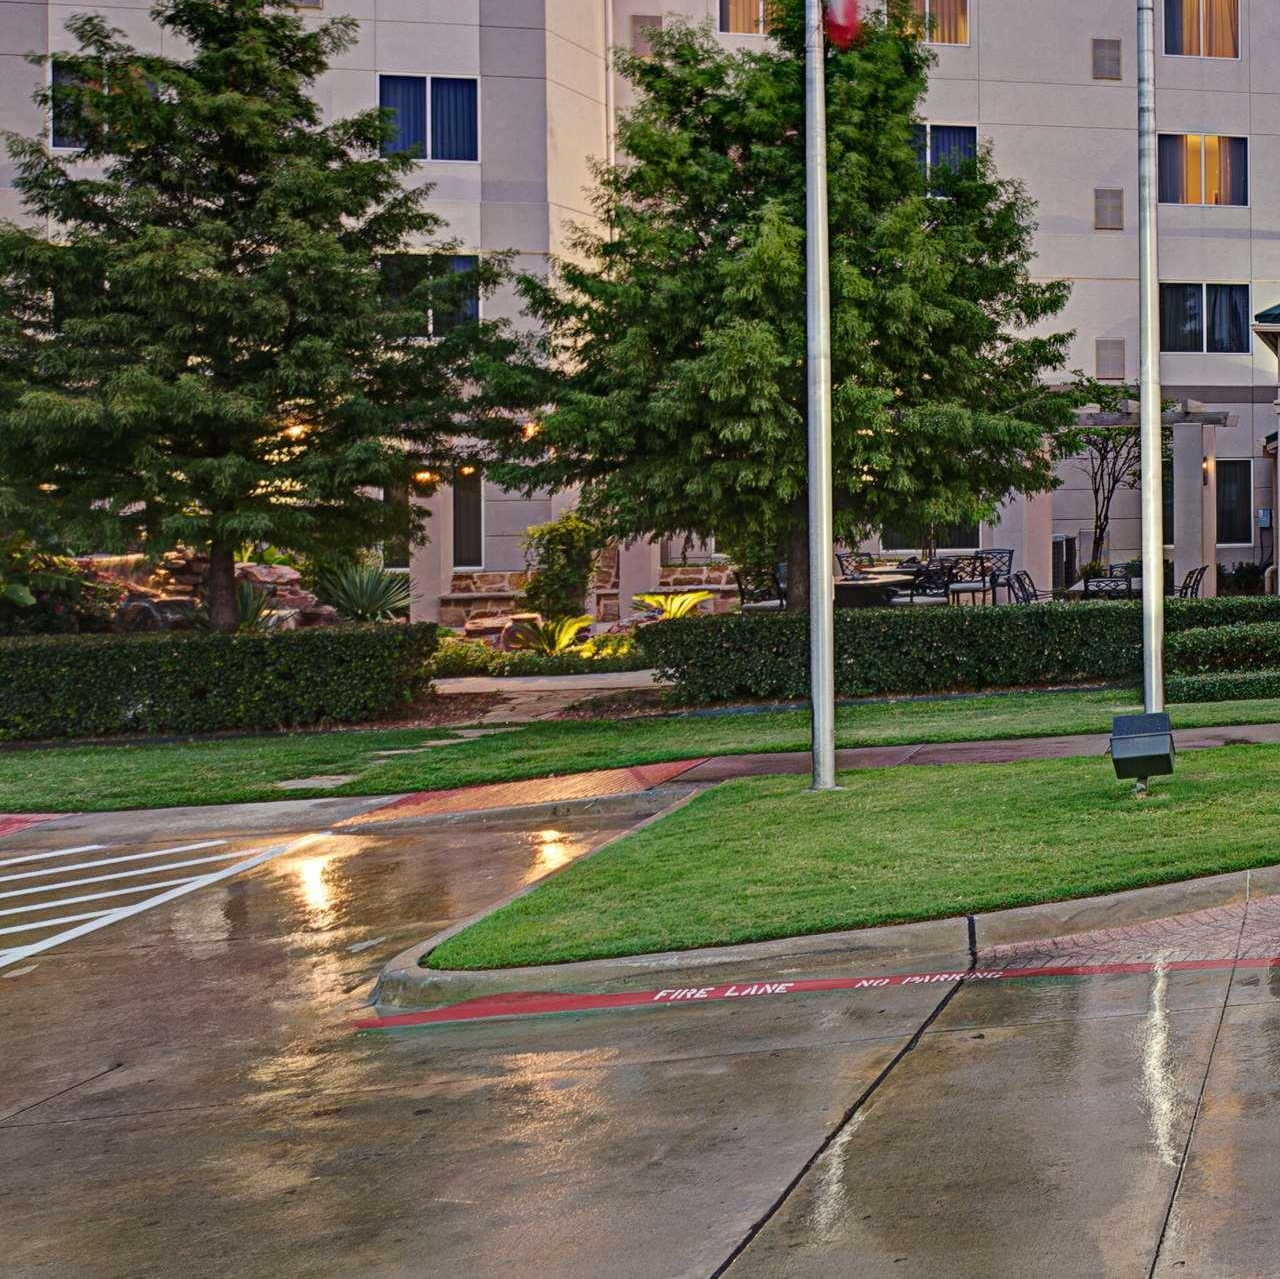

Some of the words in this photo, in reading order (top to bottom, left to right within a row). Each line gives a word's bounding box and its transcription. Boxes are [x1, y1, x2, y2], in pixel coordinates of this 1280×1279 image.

[654, 987, 716, 1001] FIRE
[724, 982, 795, 997] LANE
[855, 978, 891, 989] NO
[901, 971, 1004, 985] PARKING
